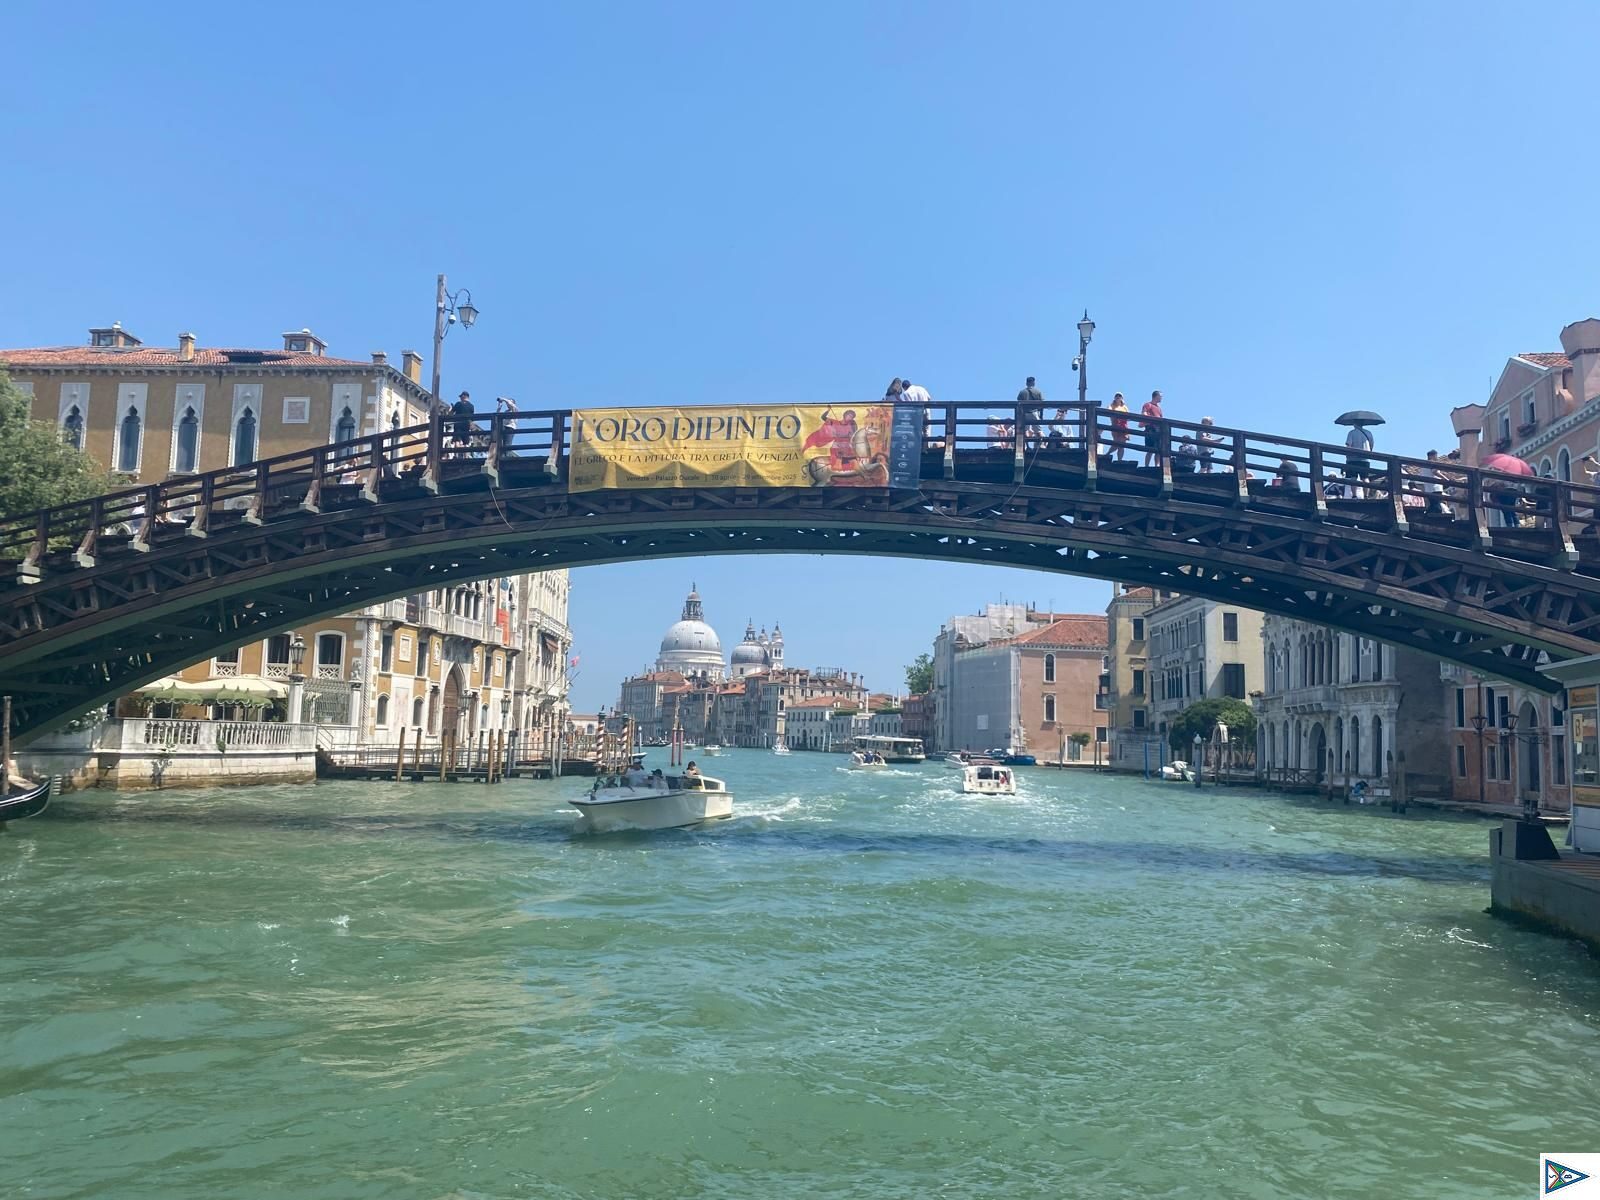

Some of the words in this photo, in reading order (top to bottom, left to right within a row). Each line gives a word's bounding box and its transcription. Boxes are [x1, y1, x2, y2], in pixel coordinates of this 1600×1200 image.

[577, 417, 666, 442] L'ORO
[672, 414, 801, 441] DIPINTO
[586, 454, 617, 464] GRECO
[628, 455, 642, 463] LA
[644, 453, 686, 463] PITTURA
[690, 453, 711, 462] TRA
[712, 452, 743, 462] CRETA
[747, 452, 754, 460] E
[756, 452, 799, 462] VENEZIA
